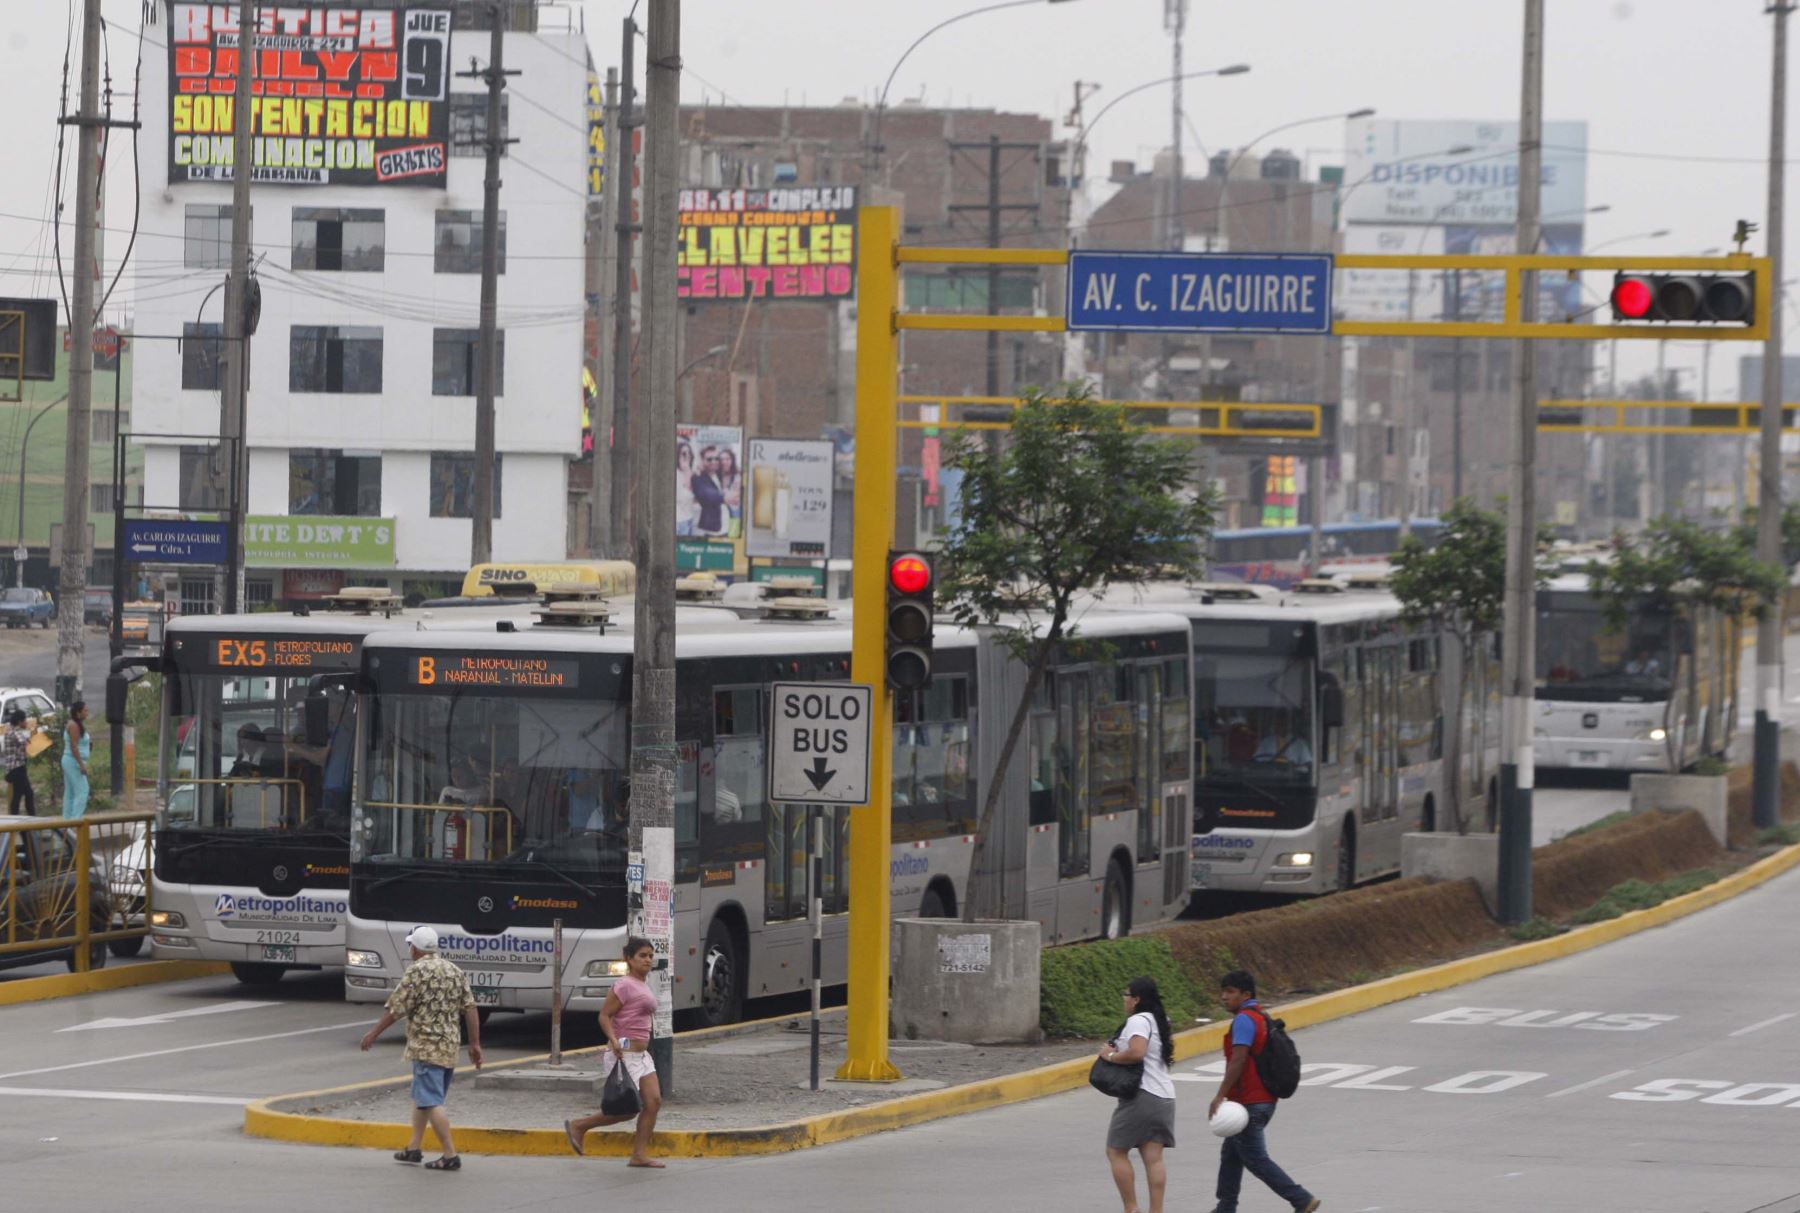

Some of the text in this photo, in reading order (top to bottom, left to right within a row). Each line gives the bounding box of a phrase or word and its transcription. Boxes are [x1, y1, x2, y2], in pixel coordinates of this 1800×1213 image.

[407, 14, 447, 32] JUE
[176, 47, 397, 80] DAILYN
[406, 37, 443, 97] 9
[174, 94, 235, 134] SON
[175, 135, 375, 169] COMINACION
[379, 146, 443, 177] GRATIS
[1372, 163, 1557, 187] DISPONIBE
[768, 188, 854, 211] COMPLEJO
[678, 226, 853, 265] LAVELES
[1083, 273, 1123, 311] AV.
[1135, 273, 1158, 312] C.
[1171, 274, 1316, 313] IZAGUIRRE
[144, 532, 176, 543] CARLOS
[177, 533, 221, 544] IZAGUIRRE
[245, 523, 290, 542] ITE
[480, 569, 527, 581] SINO
[218, 640, 353, 666] EX5 METROPOLITANO
[275, 653, 312, 666] FLORES
[418, 656, 547, 685] B METROPOLITANO
[445, 670, 501, 683] NARANJAL
[511, 672, 564, 685] MATELLINI
[784, 694, 860, 720] SOLO
[793, 728, 848, 754] BUS
[518, 897, 578, 909] modasa
[256, 930, 300, 944] 21024
[441, 951, 506, 962] MUNICIPALIDAD
[1411, 1006, 1680, 1032] BUS
[1608, 1077, 1800, 1108] SO
